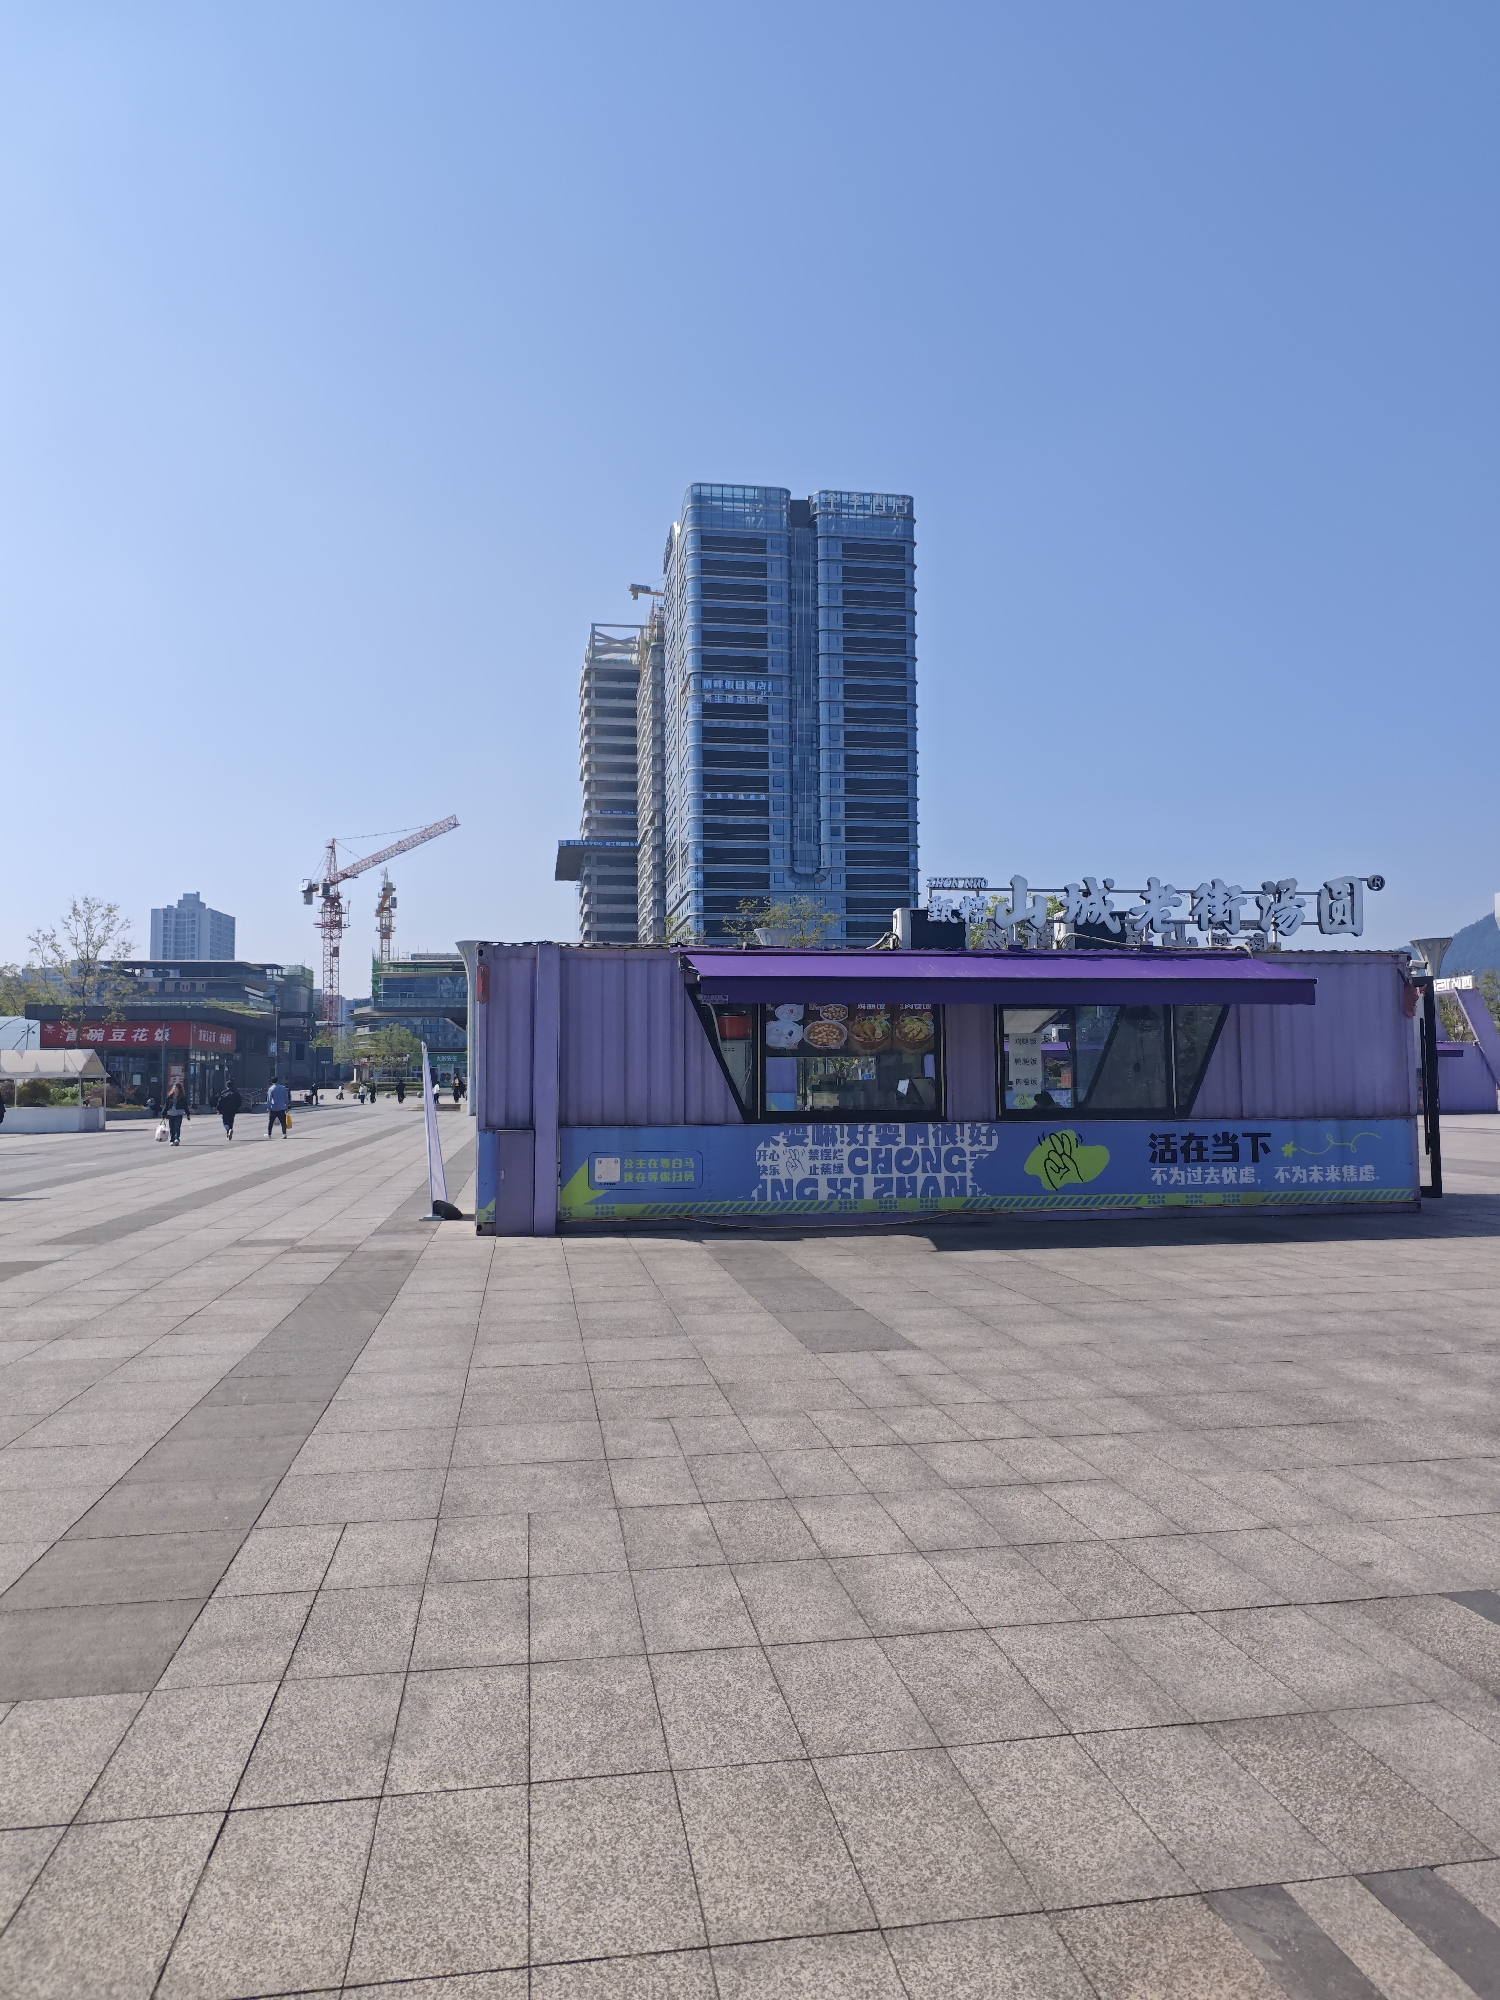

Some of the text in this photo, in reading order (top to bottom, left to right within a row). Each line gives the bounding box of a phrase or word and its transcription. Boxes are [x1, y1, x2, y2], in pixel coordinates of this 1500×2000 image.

[824, 493, 911, 515] 全季酒店
[757, 1149, 781, 1162] 开心
[1148, 1132, 1272, 1164] 活在当下
[623, 1158, 695, 1169] 公主在等白马
[847, 1146, 967, 1175] CHONG
[1273, 1165, 1381, 1184] 不为未来焦虑。
